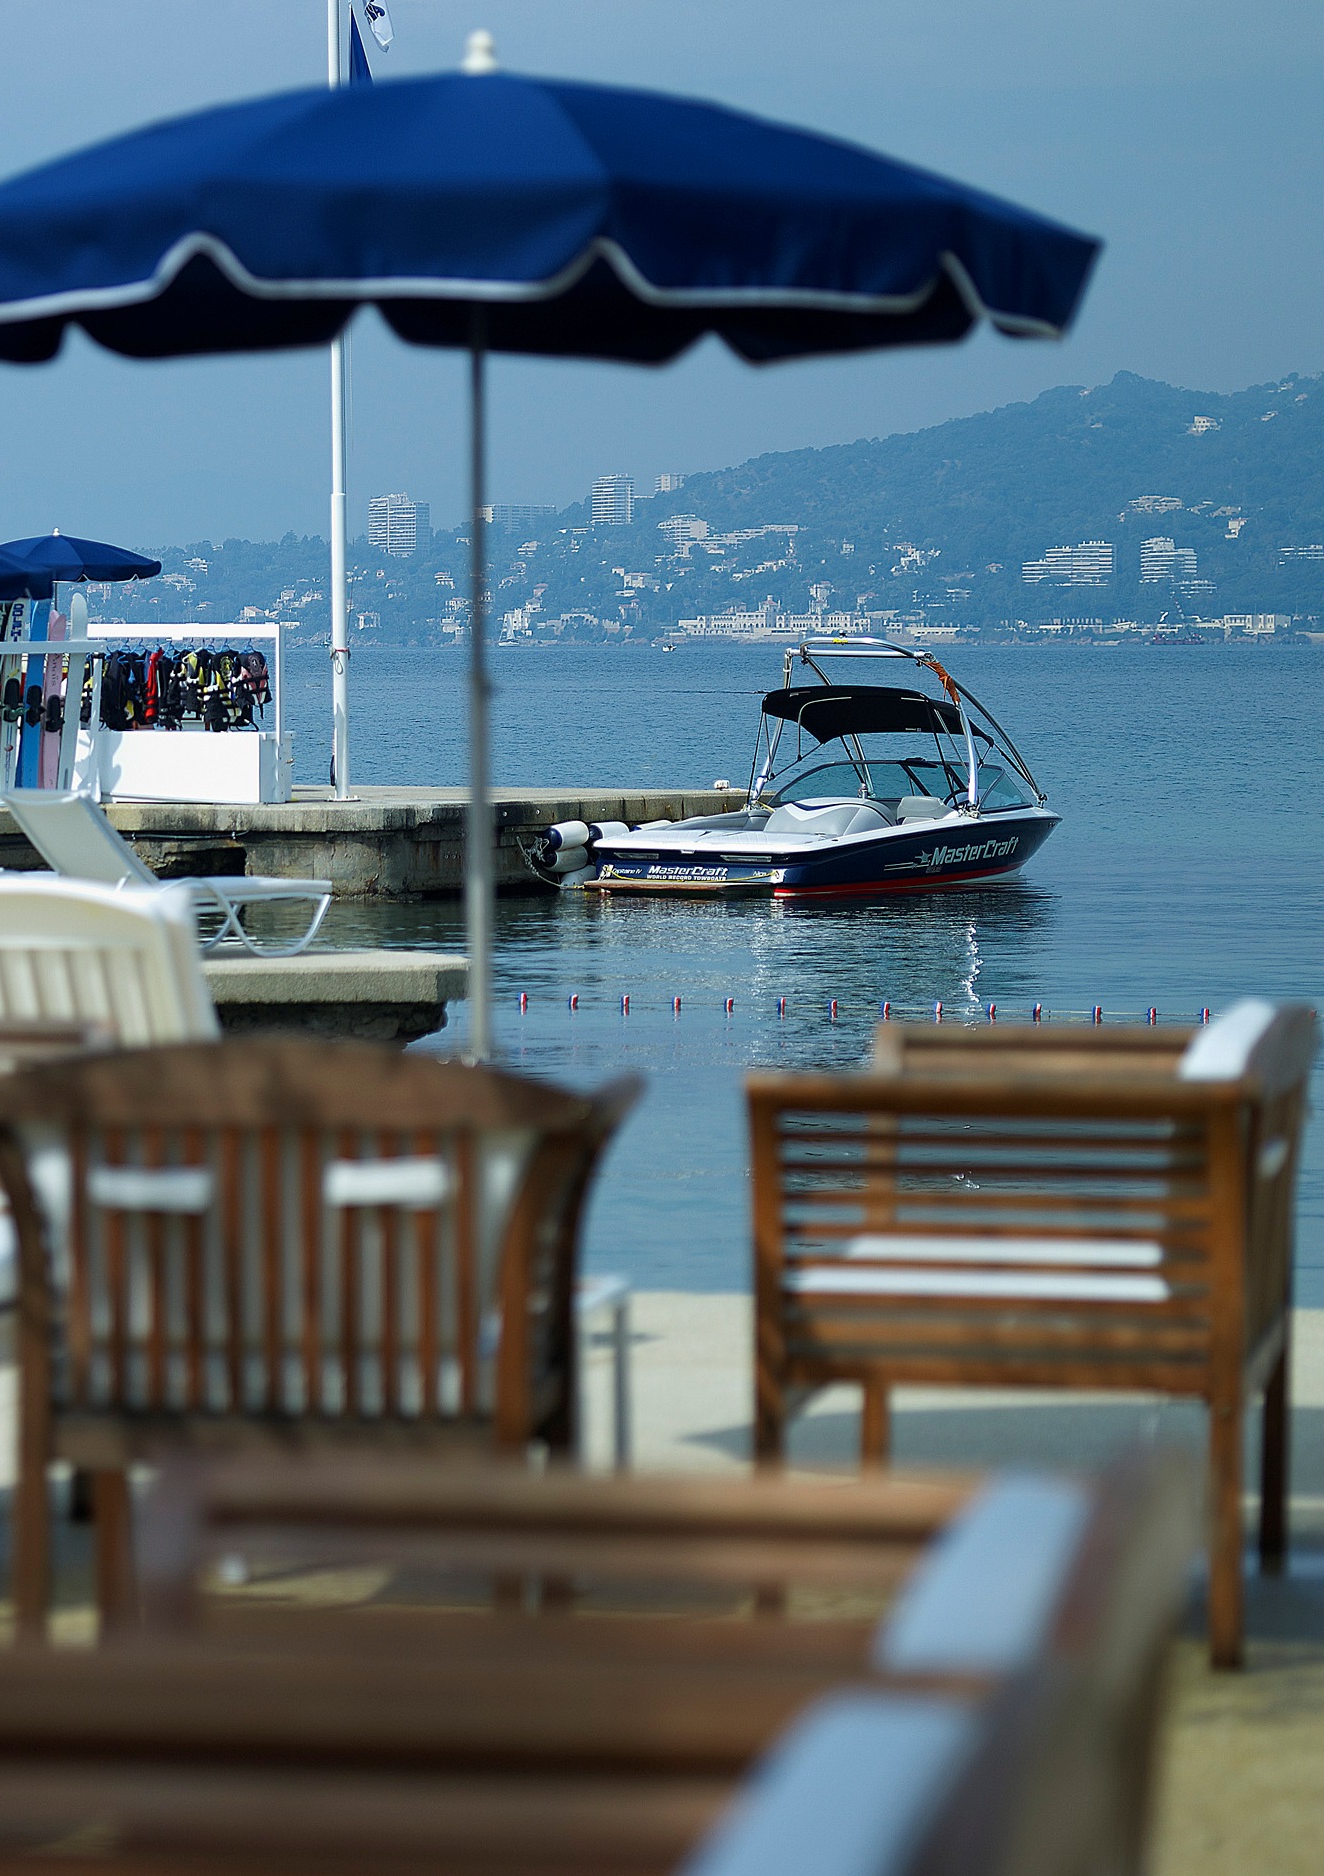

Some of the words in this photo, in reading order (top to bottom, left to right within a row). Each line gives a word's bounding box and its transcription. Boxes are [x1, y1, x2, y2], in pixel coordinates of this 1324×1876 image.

[10, 603, 25, 642] DOLPHI
[931, 836, 1019, 866] MasterCraft
[648, 865, 728, 876] MasterCraft
